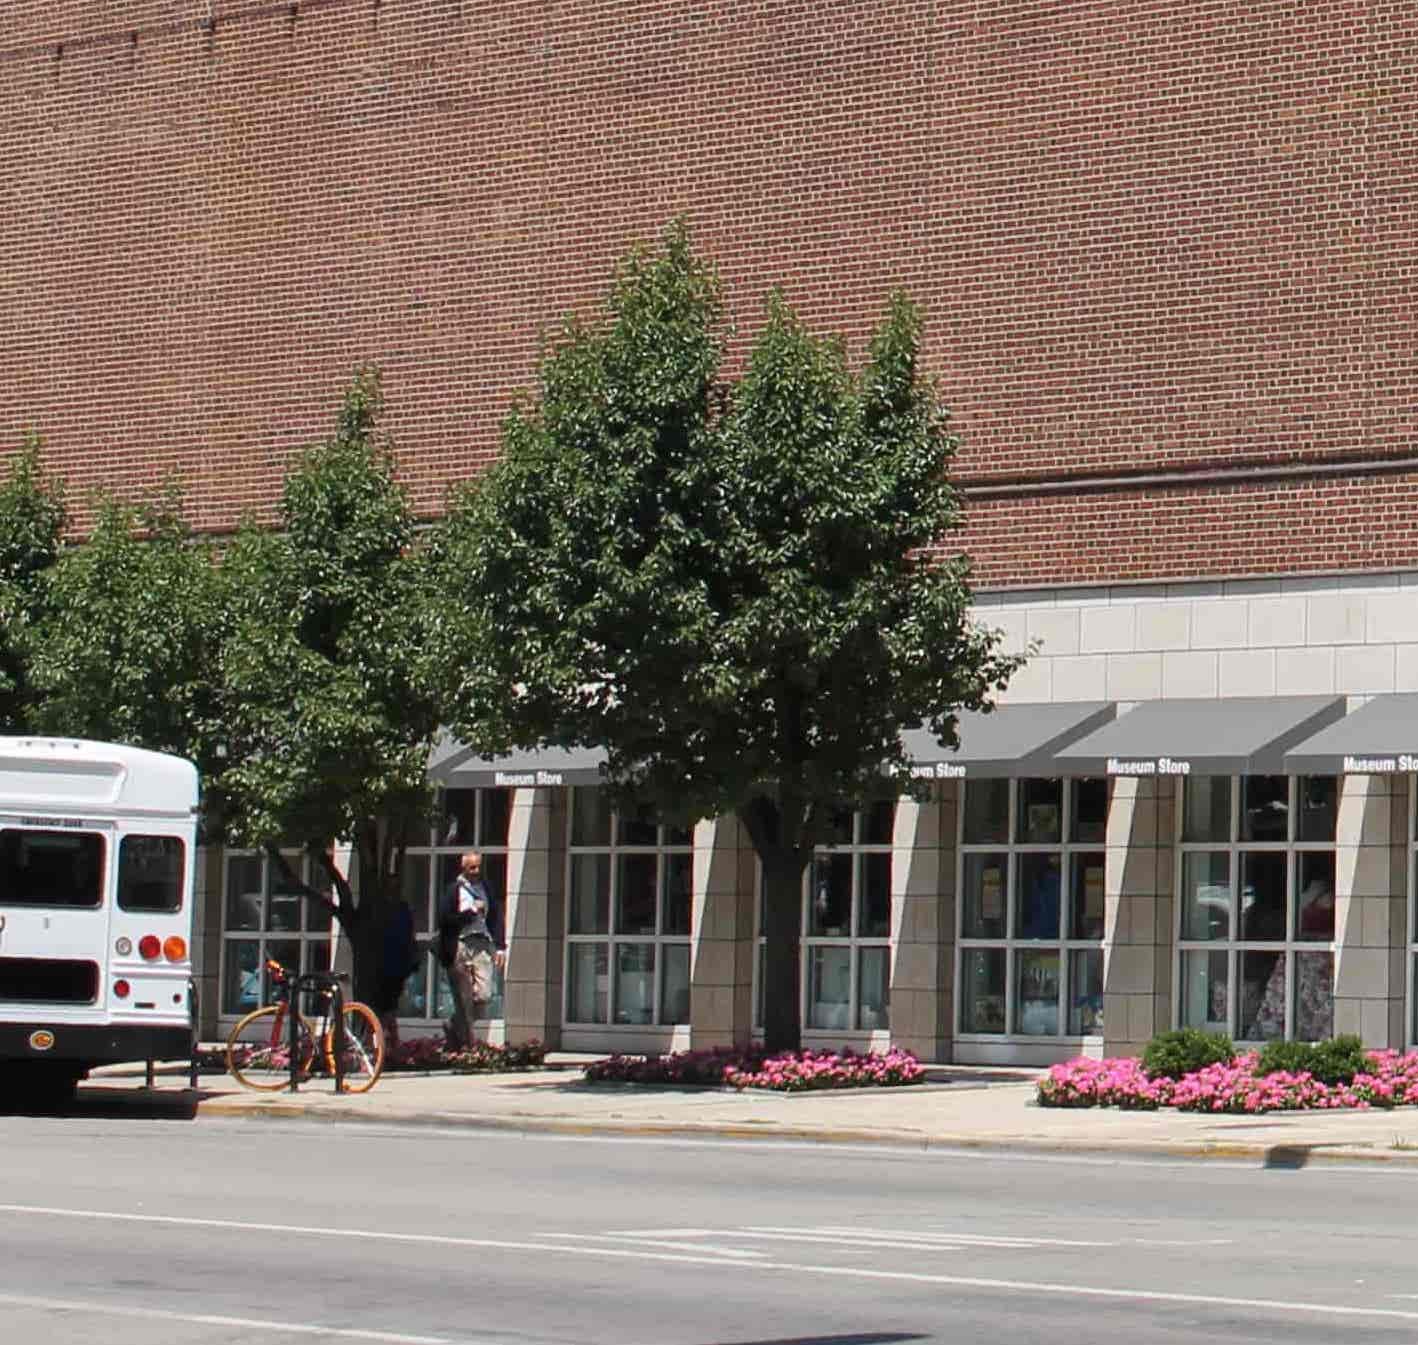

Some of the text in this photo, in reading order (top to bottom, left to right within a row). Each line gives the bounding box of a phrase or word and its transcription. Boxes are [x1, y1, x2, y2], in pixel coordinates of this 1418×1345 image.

[936, 763, 966, 777] Store
[1106, 758, 1190, 774] Museum Store
[1344, 756, 1396, 772] Museum
[495, 770, 562, 785] Museum Store
